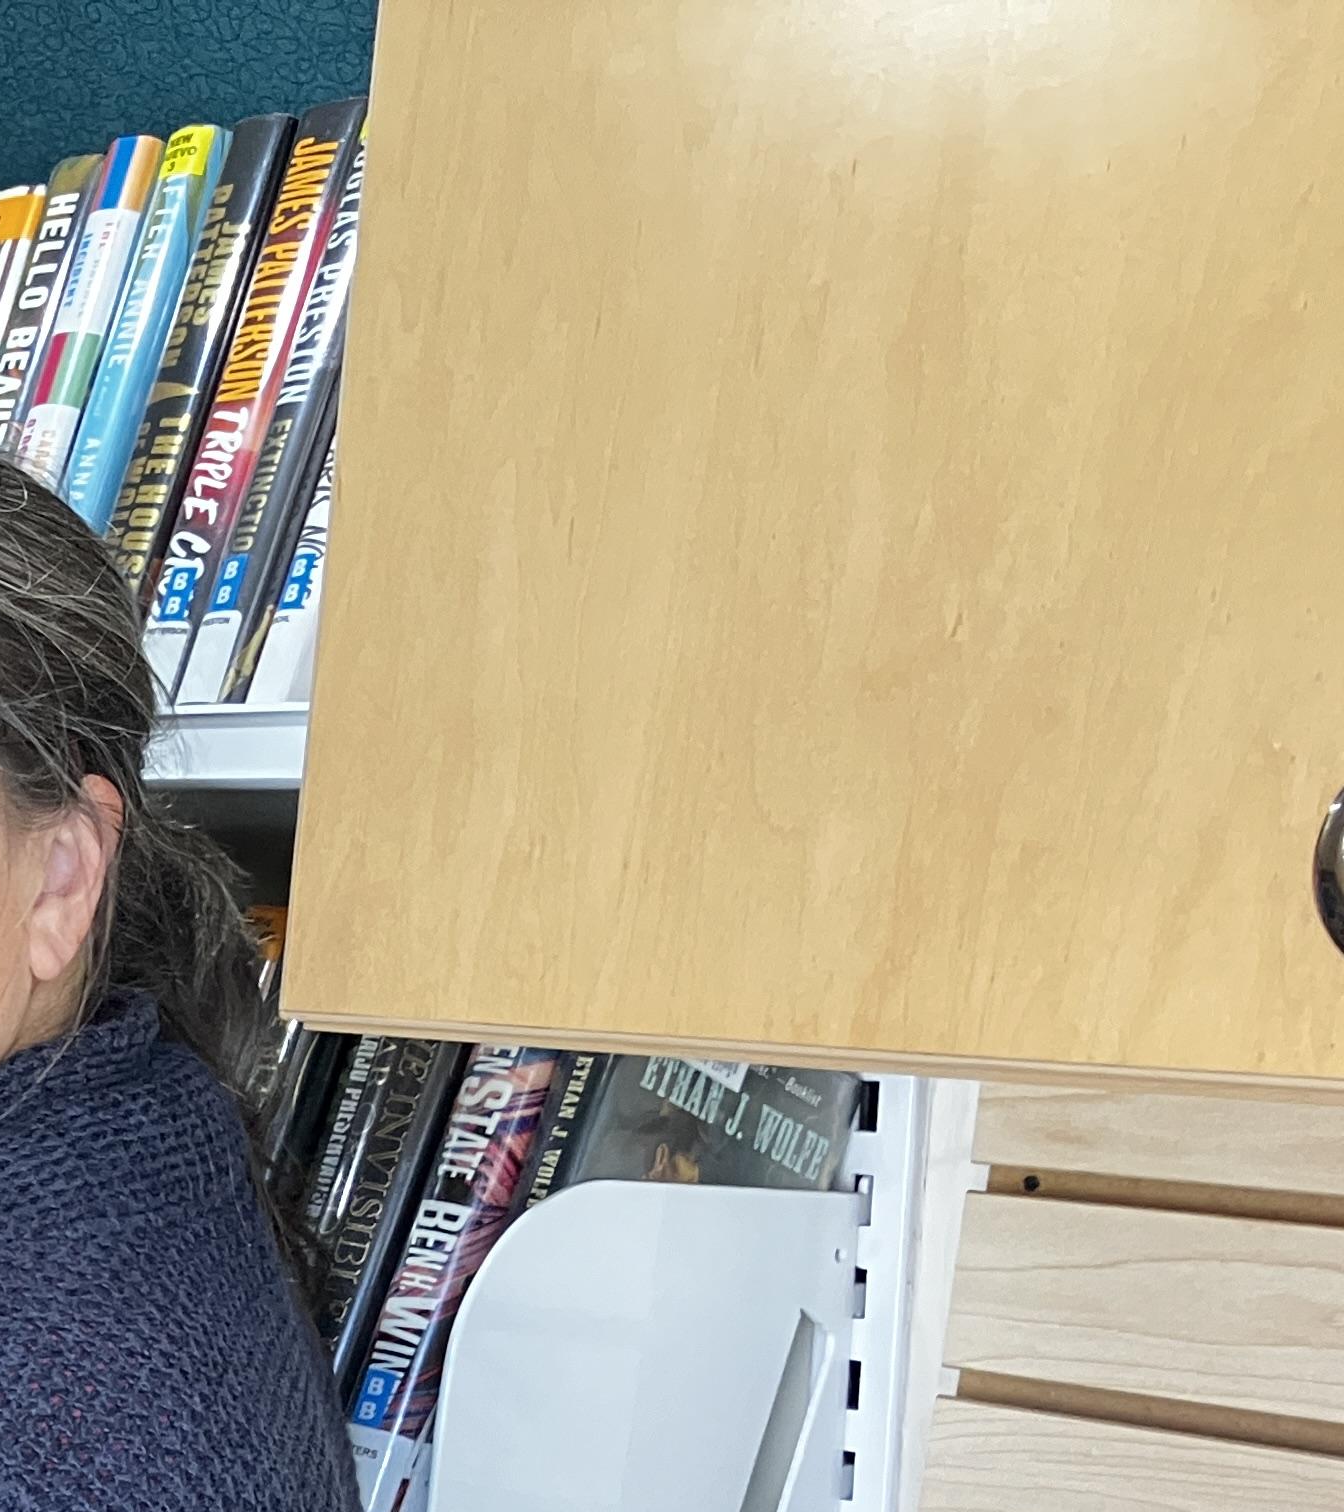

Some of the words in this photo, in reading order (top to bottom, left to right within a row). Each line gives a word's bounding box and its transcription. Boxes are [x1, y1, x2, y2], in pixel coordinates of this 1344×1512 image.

[170, 133, 192, 144] NEW
[268, 137, 339, 235] JAMES
[18, 192, 82, 311] HELLO
[193, 222, 240, 326] JAMES
[107, 262, 157, 369] ANNIE
[216, 242, 302, 402] PATTERSON
[142, 413, 191, 474] THE
[183, 407, 249, 525] TRIPLE
[173, 572, 189, 591] B
[216, 586, 231, 605] B
[224, 561, 239, 579] B
[284, 583, 300, 603] B
[291, 559, 307, 577] B
[165, 597, 181, 616] B
[558, 1056, 595, 1120] ETHAN
[639, 1055, 726, 1124] ETHAN
[724, 1091, 750, 1141] J.
[752, 1103, 830, 1181] WOLFE
[438, 1075, 513, 1184] STATE
[405, 1199, 474, 1272] BEN
[399, 1271, 439, 1291] H.
[359, 1401, 377, 1420] B
[368, 1378, 385, 1396] B
